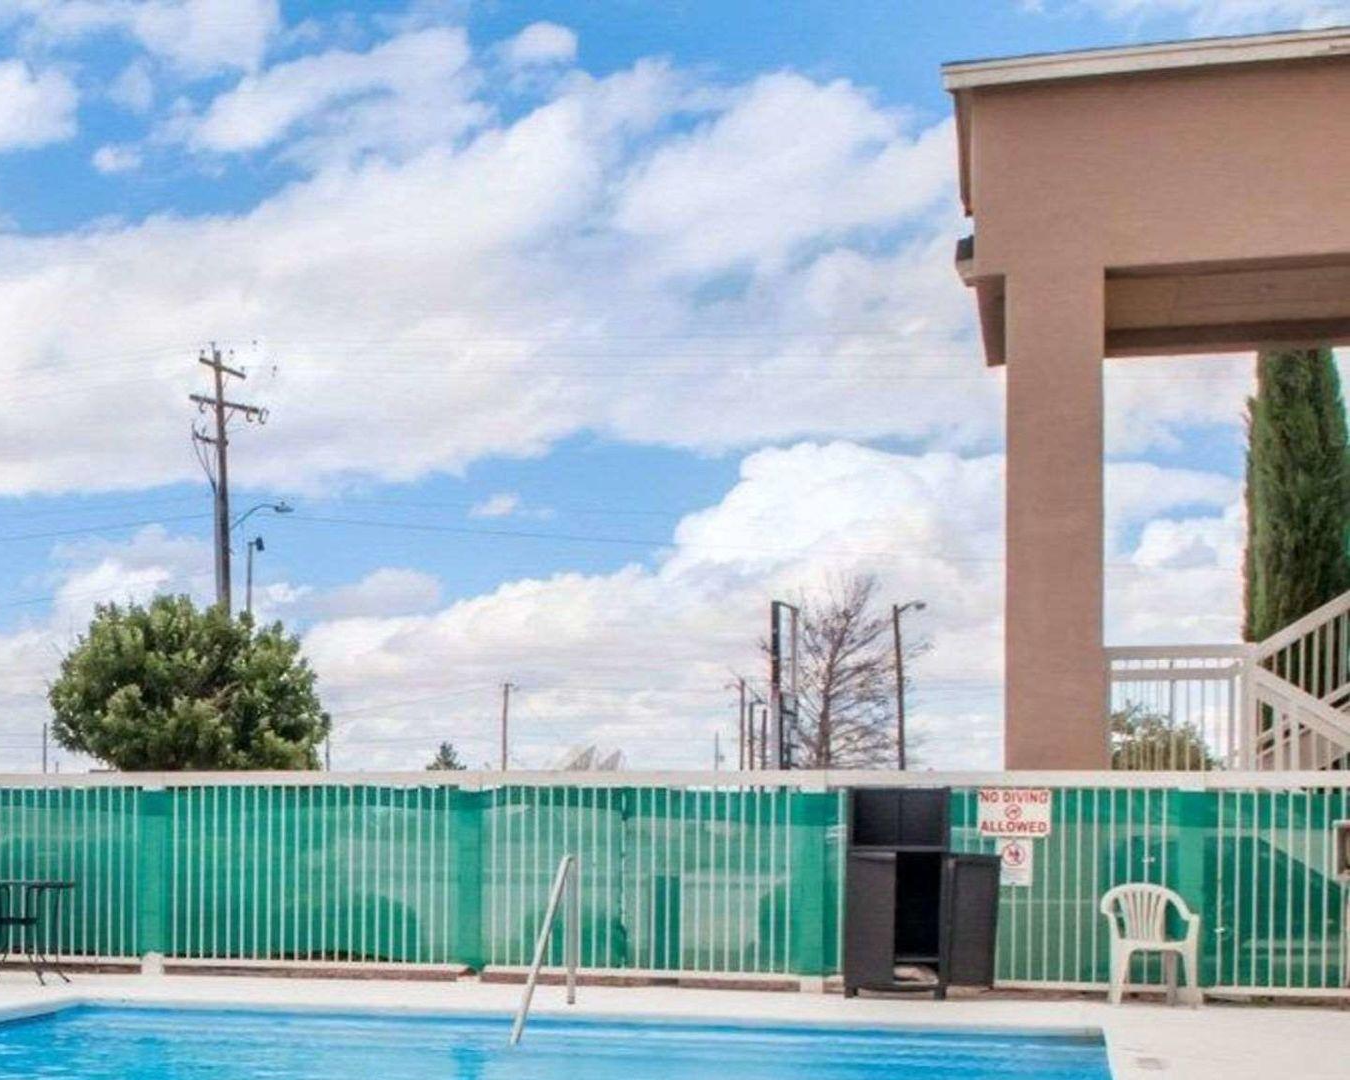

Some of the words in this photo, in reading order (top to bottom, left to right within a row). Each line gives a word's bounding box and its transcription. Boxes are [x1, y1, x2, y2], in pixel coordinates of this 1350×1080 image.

[980, 791, 999, 803] NO
[1002, 791, 1048, 803] DIVING
[981, 820, 1047, 832] ALLOWED
